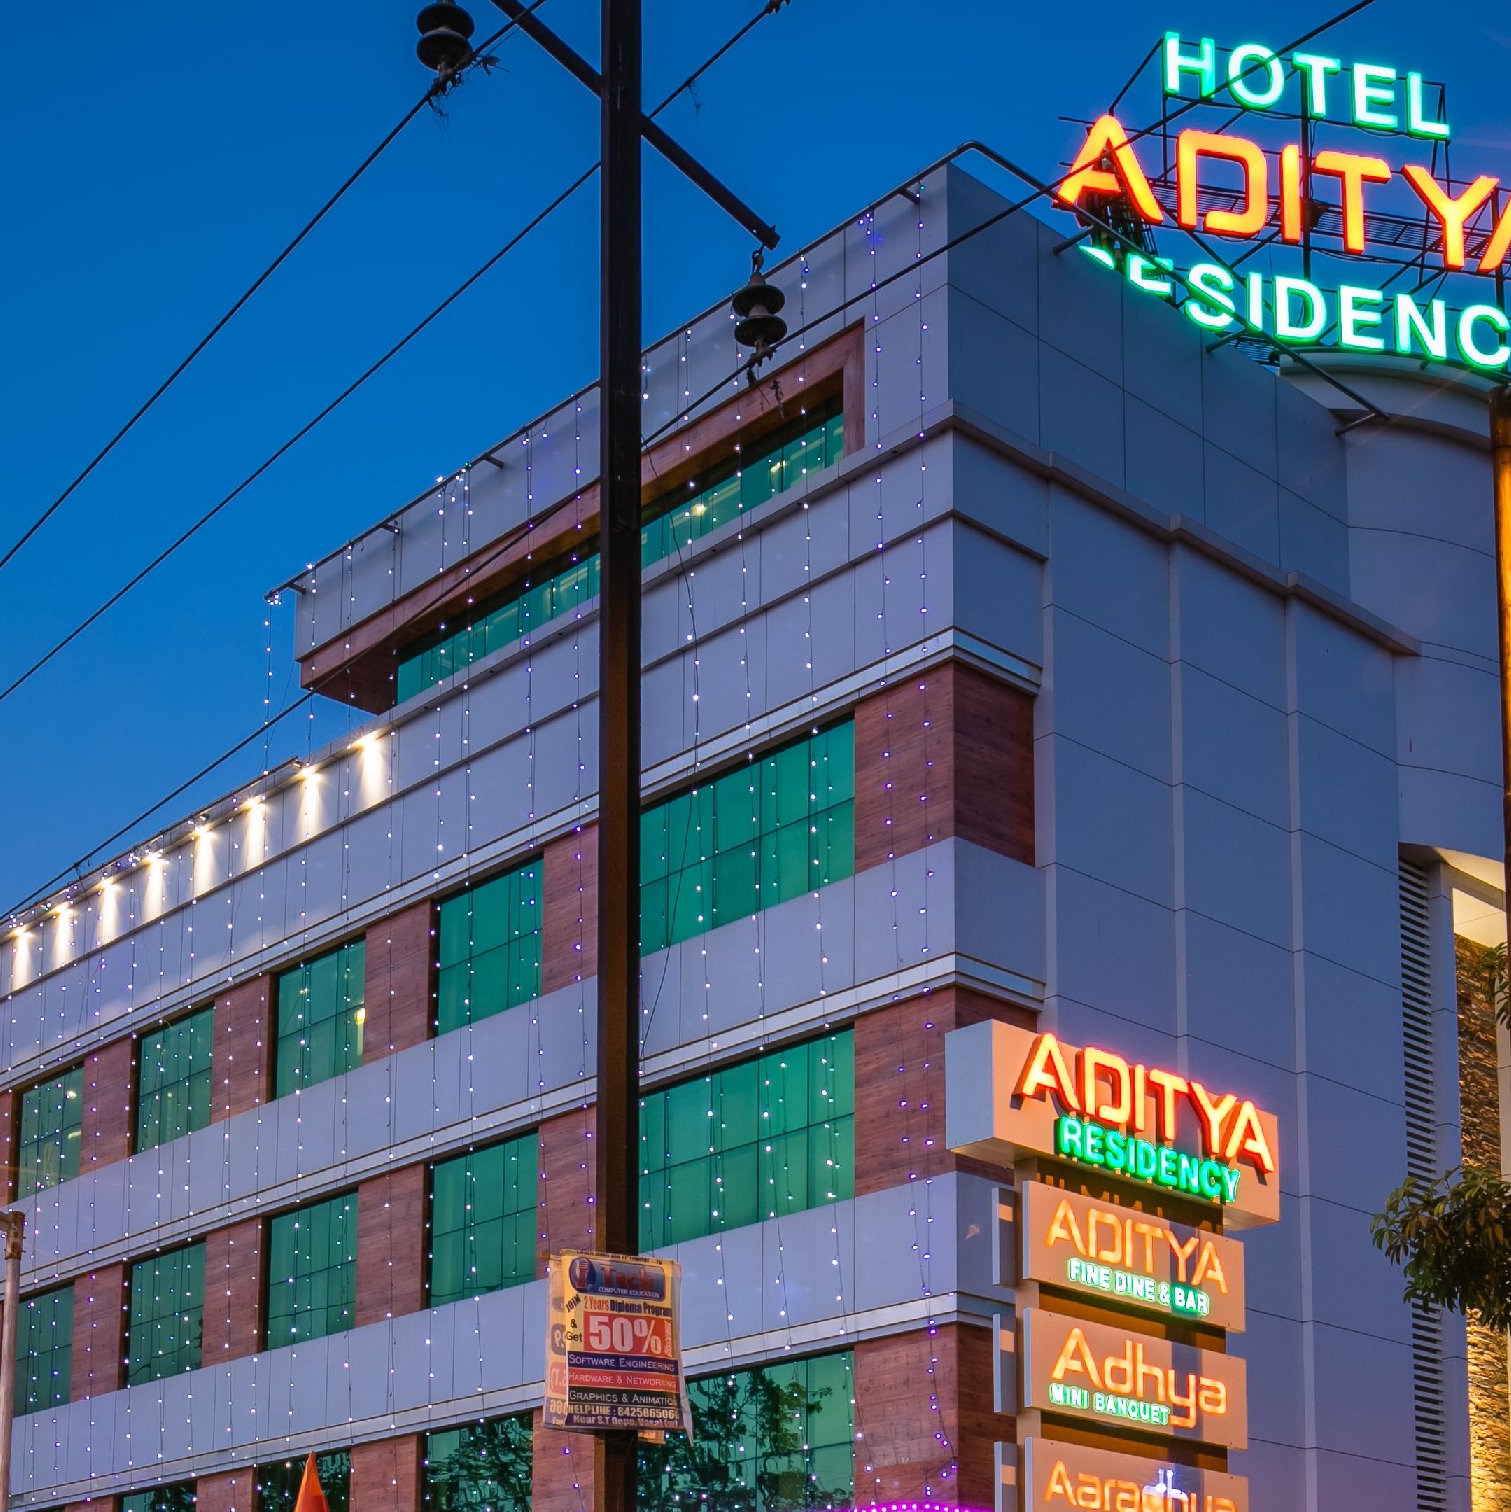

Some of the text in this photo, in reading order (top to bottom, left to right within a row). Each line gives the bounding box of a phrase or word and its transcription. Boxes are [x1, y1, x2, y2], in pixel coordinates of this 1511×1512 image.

[1162, 31, 1451, 139] HOTEL
[1018, 1033, 1275, 1173] ADITYA
[1056, 1113, 1241, 1203] RESIDENCY
[1045, 1198, 1229, 1294] ADITYA
[589, 1297, 609, 1311] Years
[610, 1299, 642, 1314] Diploma
[598, 1286, 660, 1299] COMPUTER EDUCATION
[1068, 1257, 1209, 1315] FINE DINE & BAR
[566, 1331, 583, 1342] Get
[589, 1315, 662, 1355] 50%
[568, 1354, 675, 1372] SOFTWARE ENGINEERING
[568, 1372, 614, 1384] HARDWARE
[616, 1376, 623, 1384] &
[1050, 1327, 1227, 1428] Adhya
[567, 1403, 611, 1415] HELPLINE
[569, 1390, 618, 1402] GRAPHICS
[621, 1393, 628, 1402] &
[1049, 1382, 1170, 1426] MINI BANQUET
